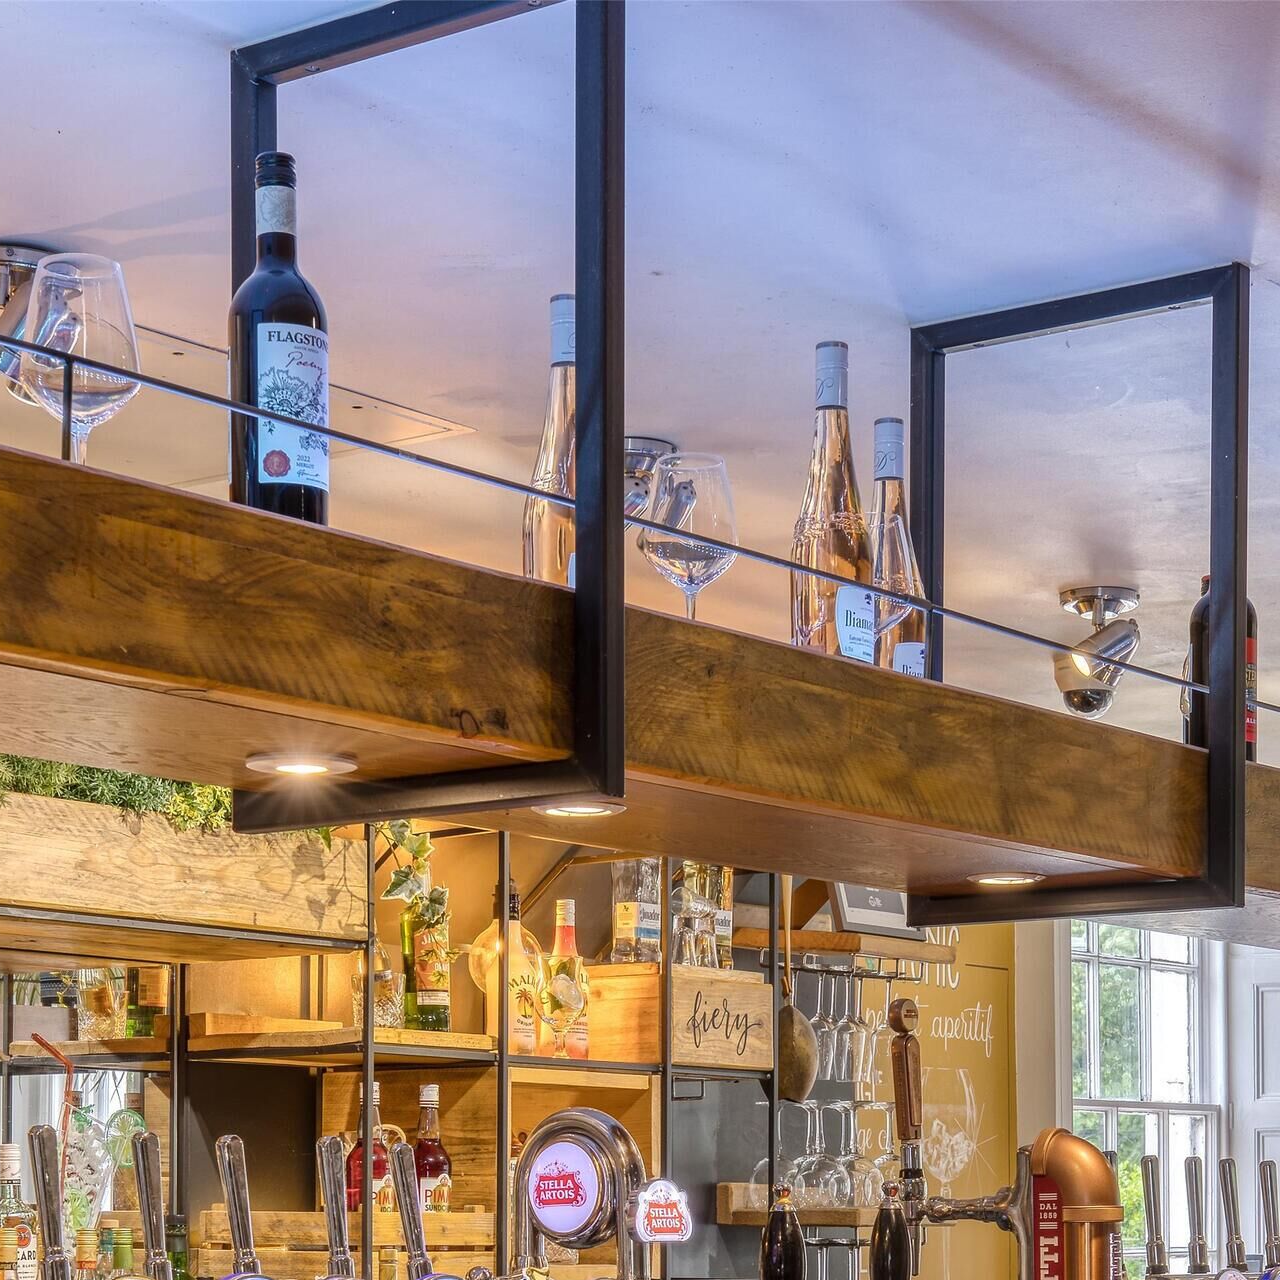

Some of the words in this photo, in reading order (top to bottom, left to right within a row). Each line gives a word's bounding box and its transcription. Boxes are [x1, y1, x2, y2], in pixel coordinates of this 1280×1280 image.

[297, 454, 311, 463] 2022
[687, 991, 762, 1055] fiery
[931, 1001, 994, 1058] aperitif
[539, 1180, 574, 1189] STELLA
[539, 1189, 575, 1200] ARTOIS
[650, 1207, 679, 1217] STELLA
[1039, 1212, 1058, 1220] 1859
[651, 1217, 680, 1228] ARTOIS
